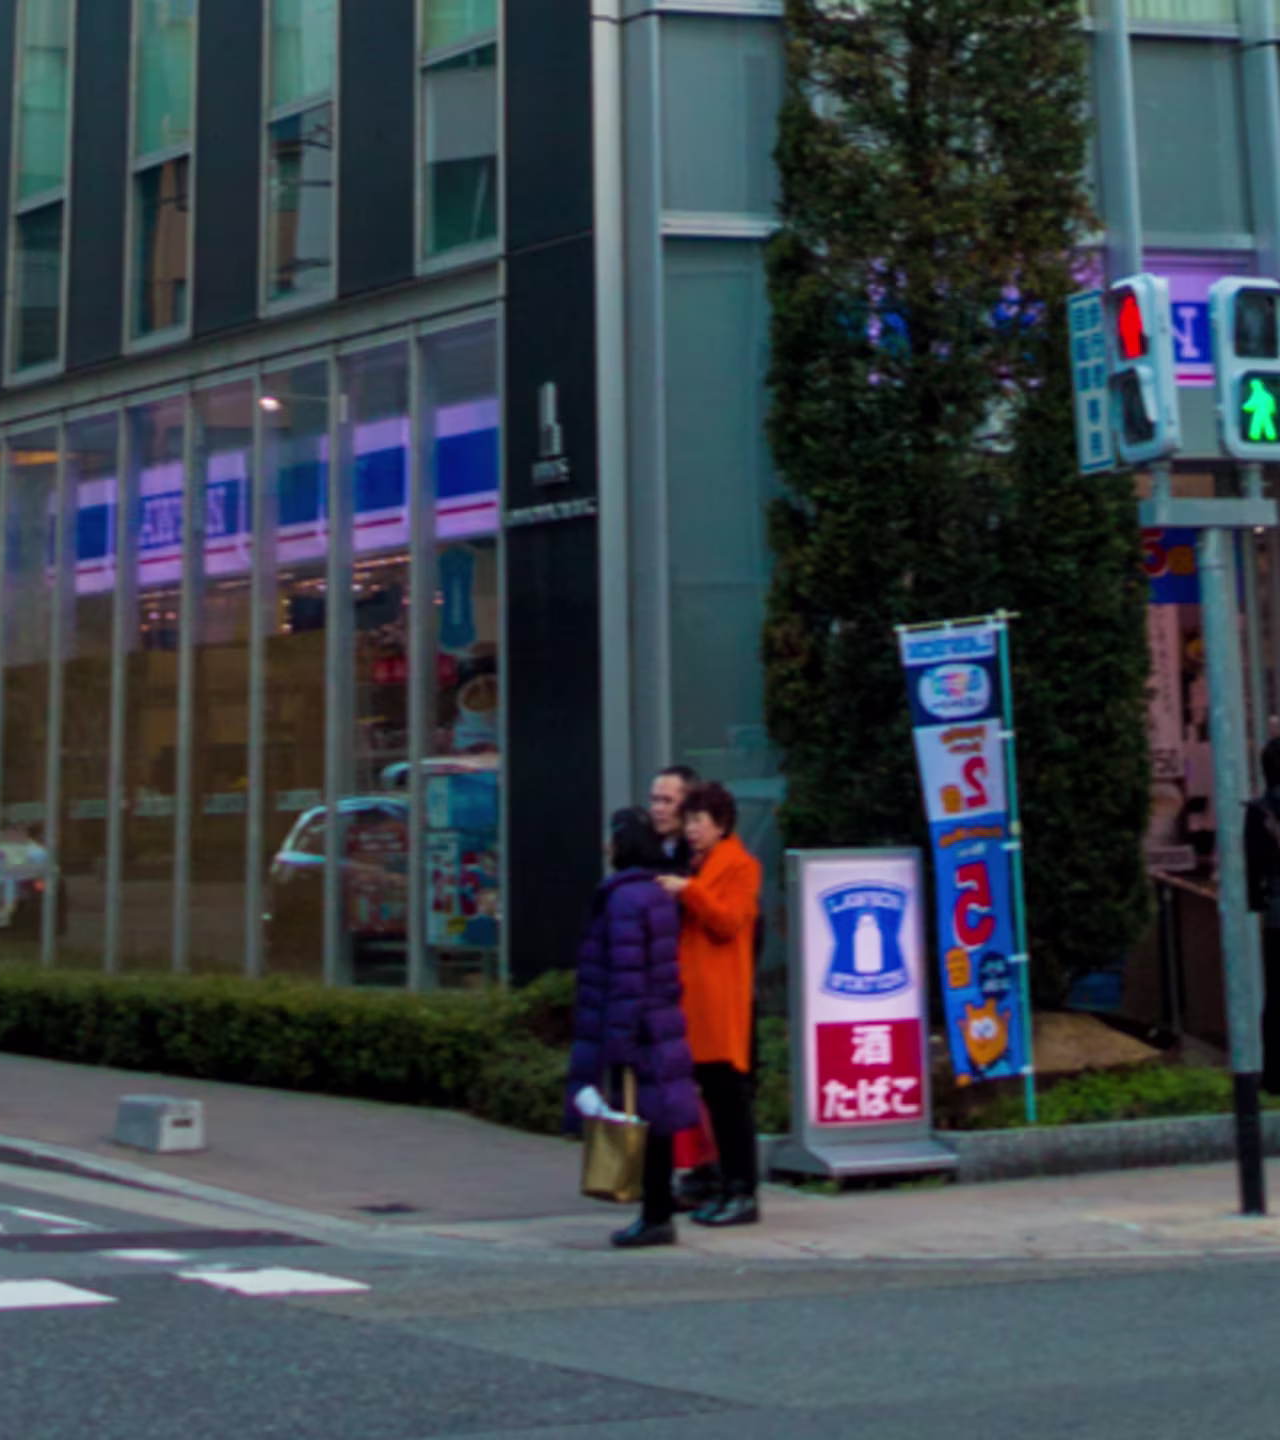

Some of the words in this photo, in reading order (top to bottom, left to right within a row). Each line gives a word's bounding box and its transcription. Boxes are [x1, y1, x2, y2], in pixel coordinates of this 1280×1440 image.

[851, 1024, 892, 1065] 酒
[822, 1075, 919, 1118] たばこ
